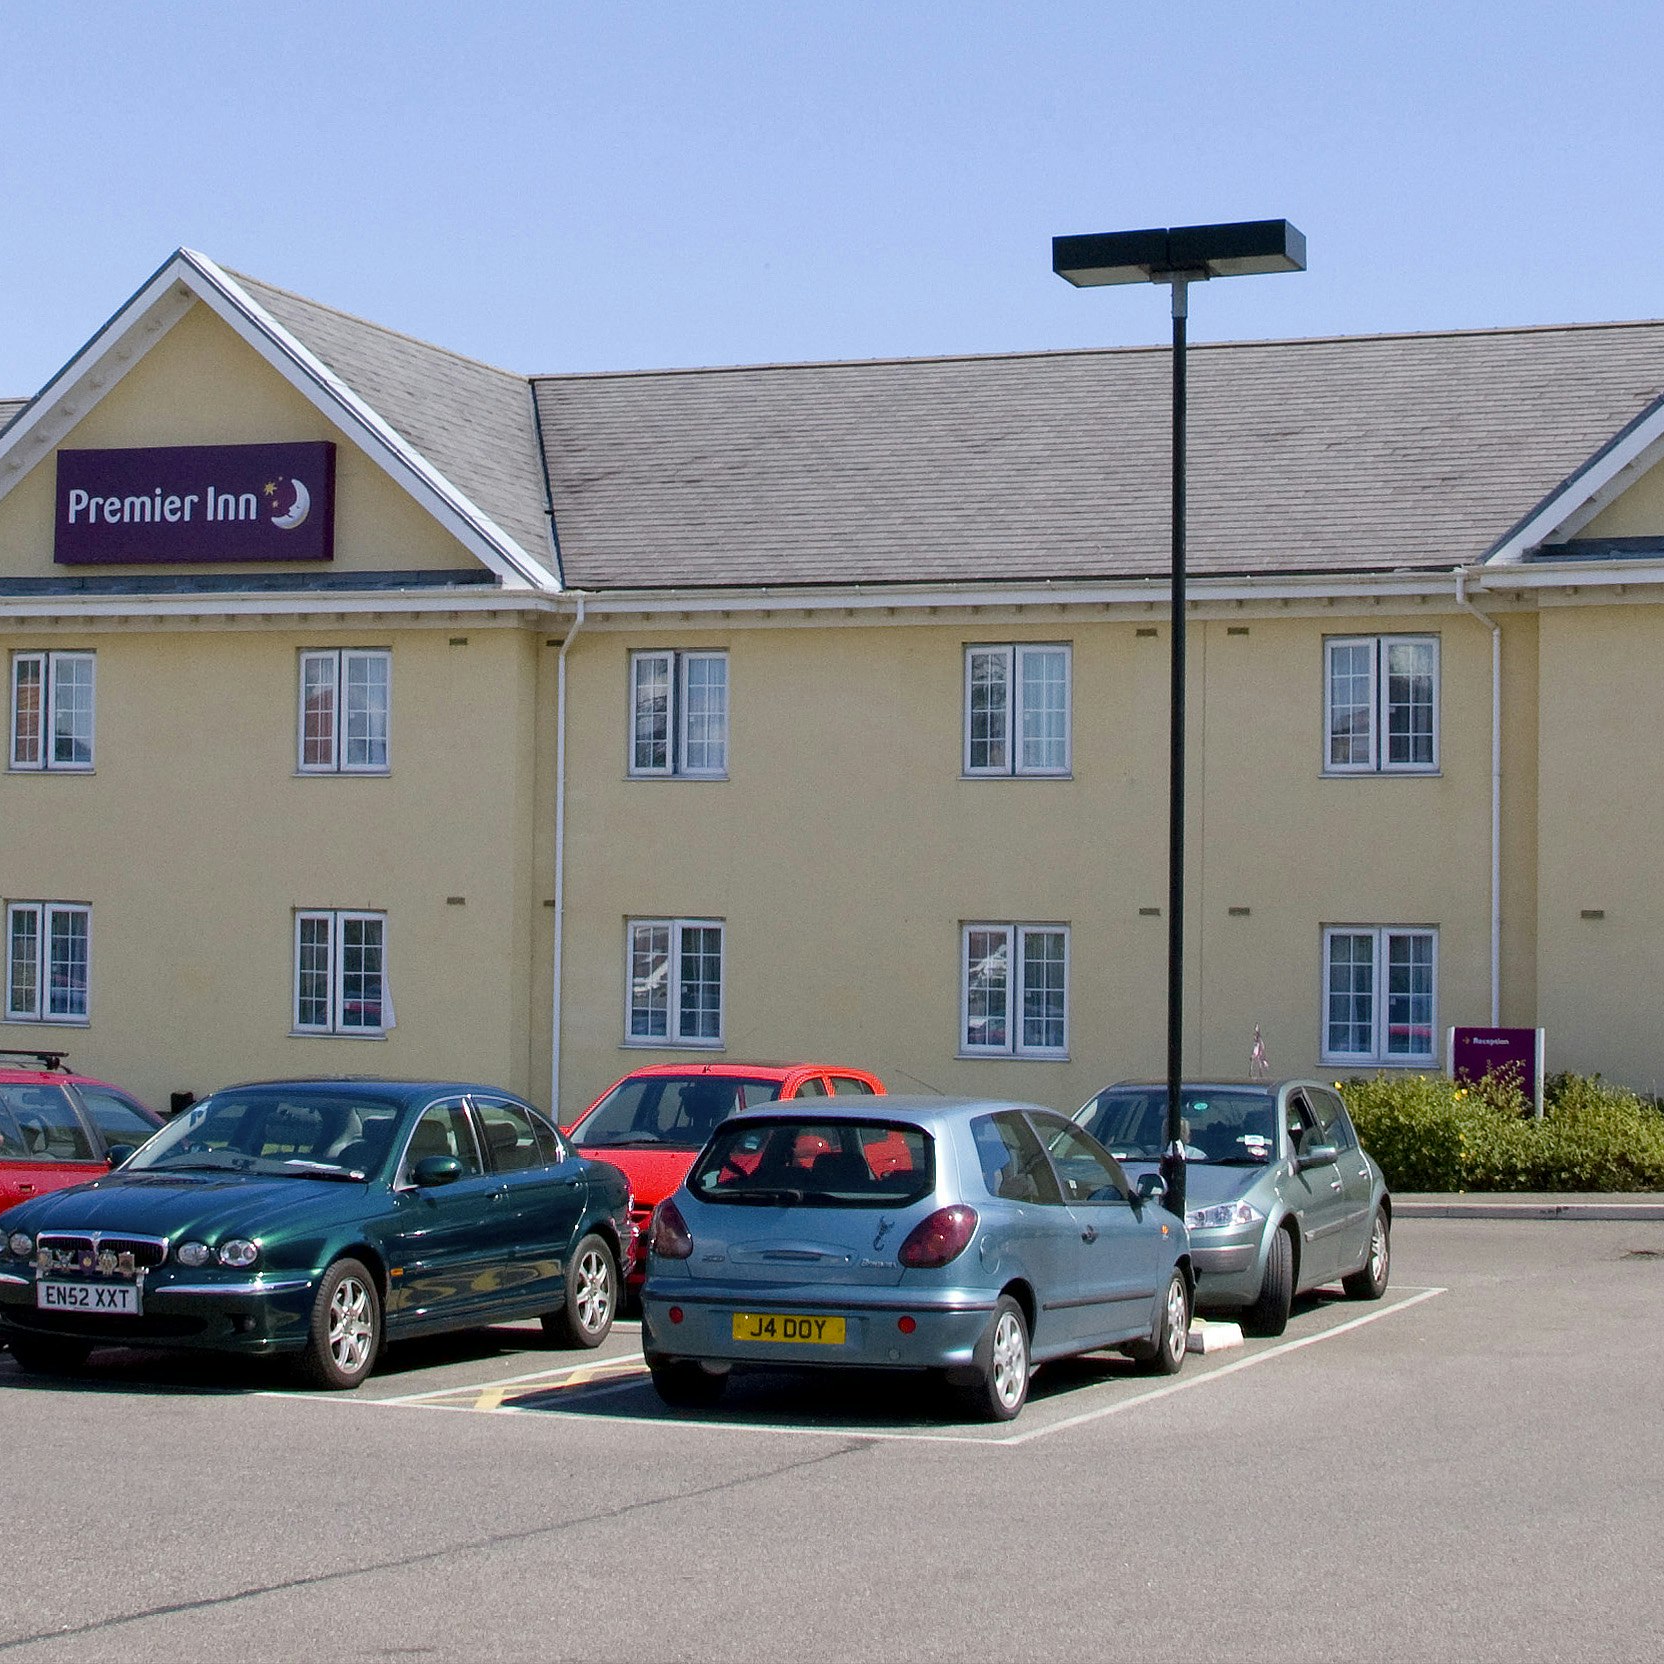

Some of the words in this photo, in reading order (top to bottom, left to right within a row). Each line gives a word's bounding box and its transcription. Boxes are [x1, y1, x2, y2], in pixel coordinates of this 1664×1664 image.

[68, 487, 199, 524] Premier
[206, 485, 257, 522] Inn
[1472, 1037, 1510, 1046] Reception
[45, 1285, 89, 1307] EN52
[95, 1287, 129, 1309] XXT
[750, 1317, 777, 1338] J4
[783, 1318, 827, 1340] DOY
